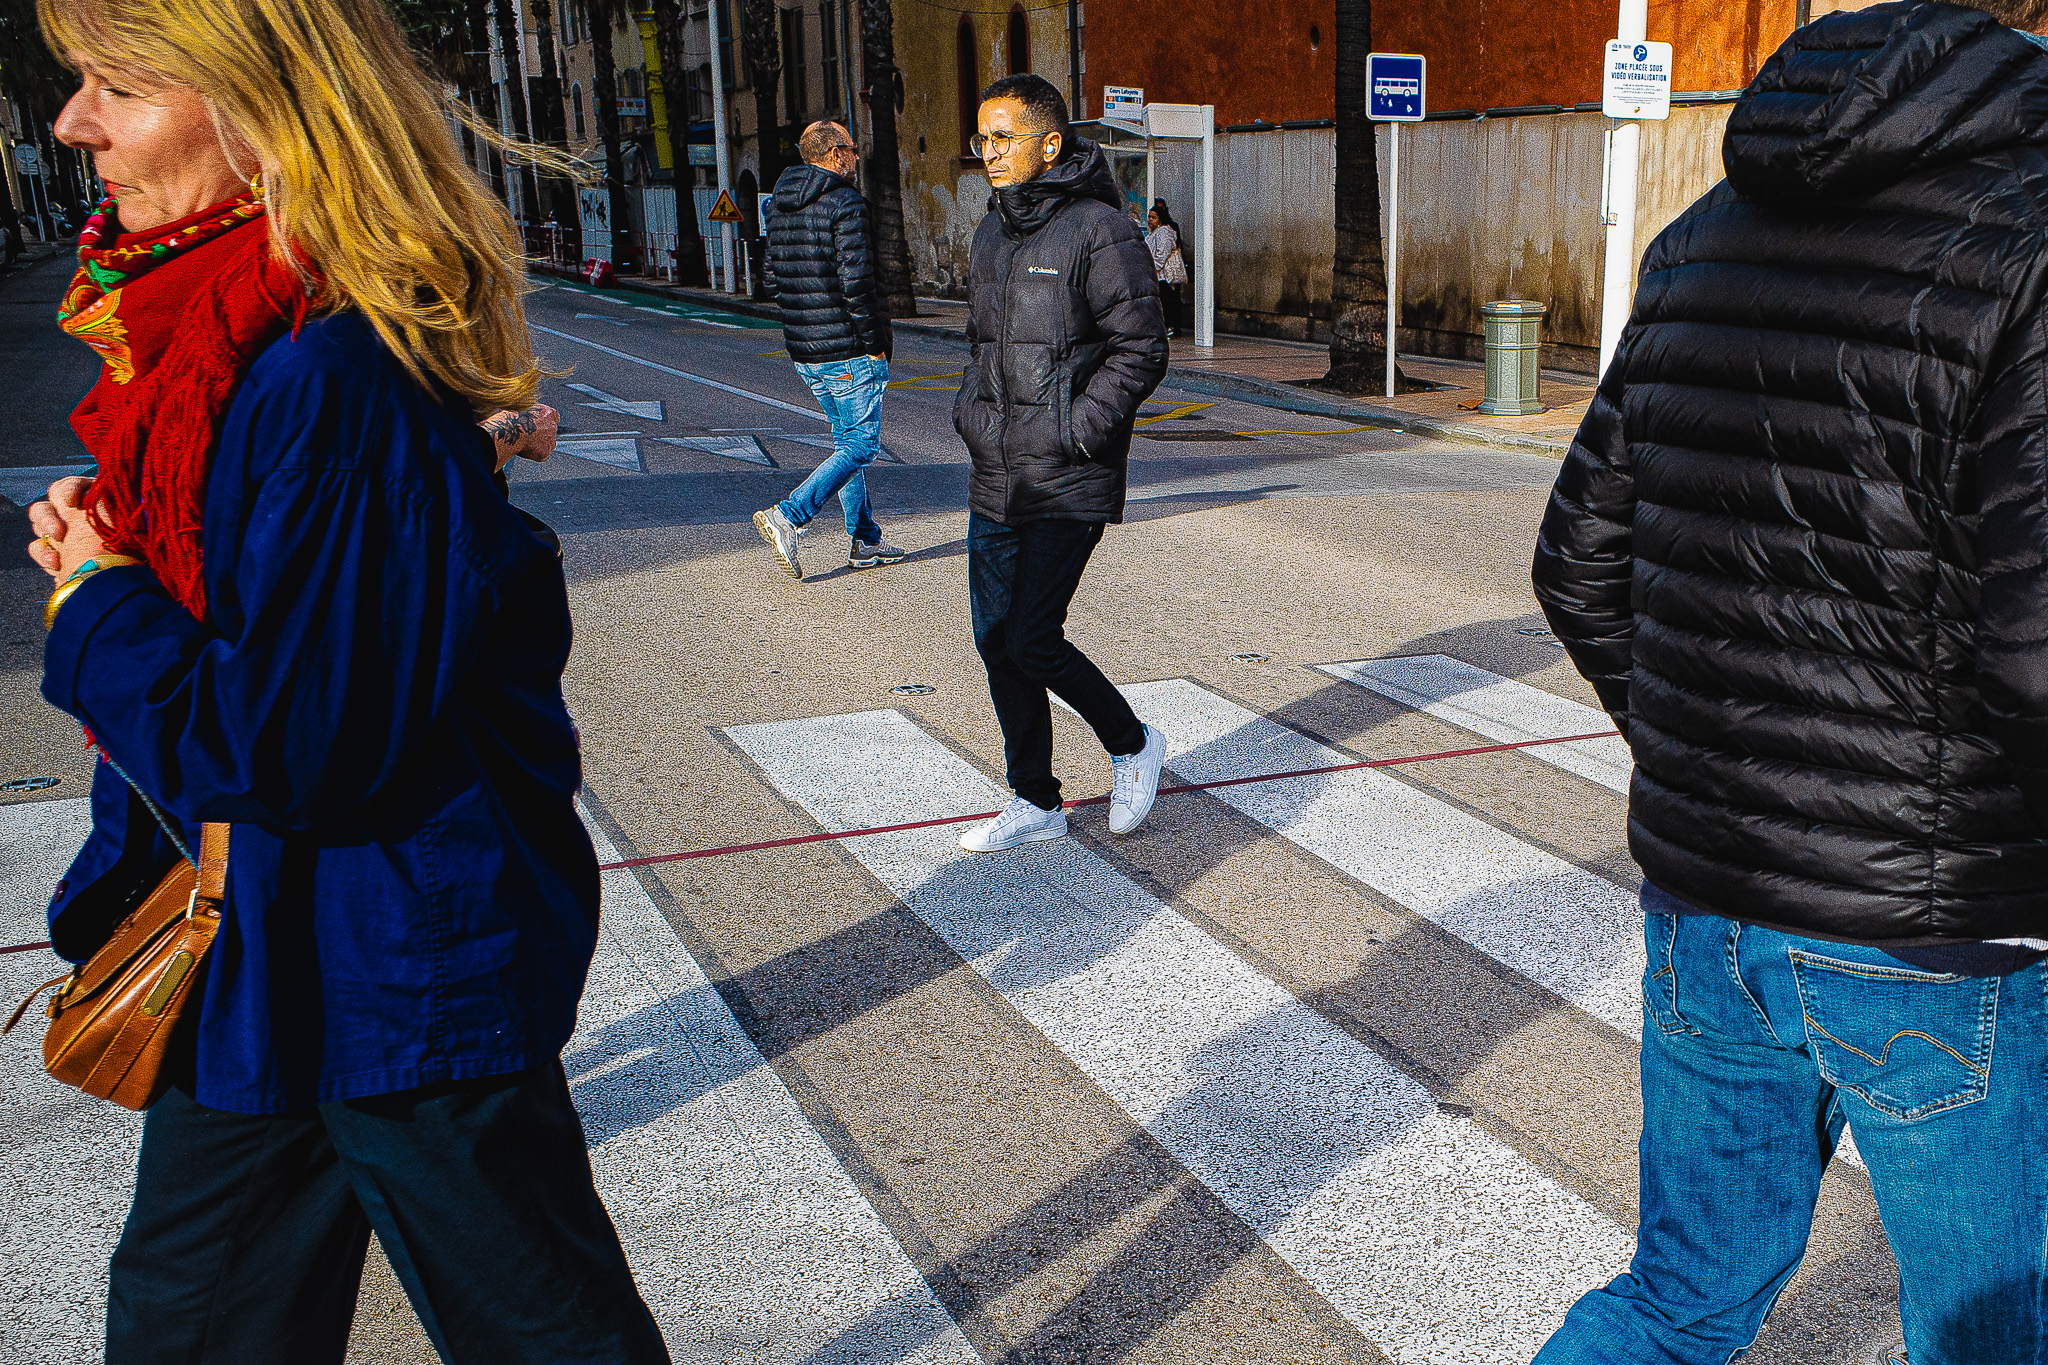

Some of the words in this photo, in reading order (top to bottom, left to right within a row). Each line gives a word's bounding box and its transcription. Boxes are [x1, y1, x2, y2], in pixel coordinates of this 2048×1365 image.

[1614, 62, 1628, 71] ZONE
[1629, 62, 1648, 72] PLACÉE
[1649, 64, 1663, 72] SOUS
[1611, 71, 1626, 80] VIDÉO
[1627, 73, 1667, 82] VERBALISATION
[1033, 266, 1059, 276] Columbia
